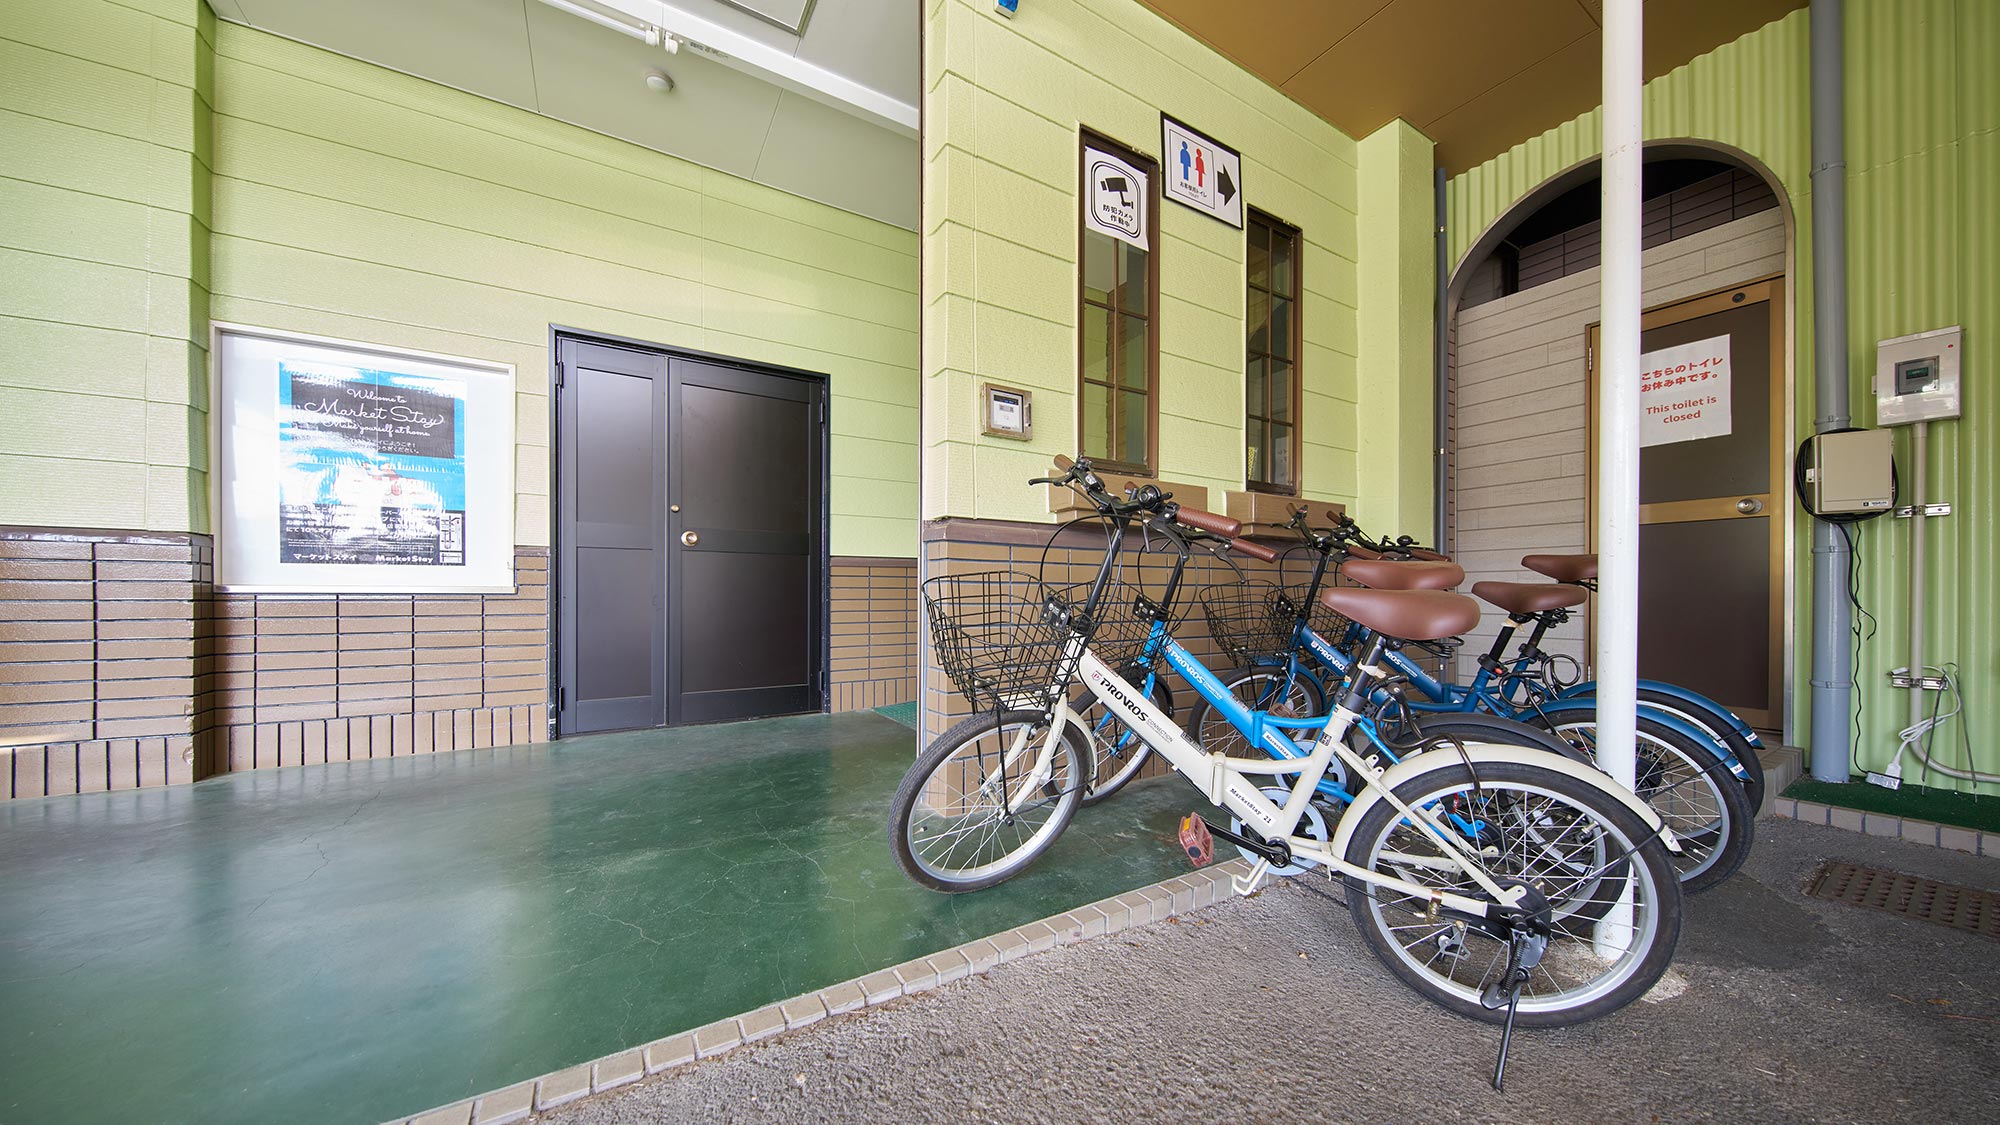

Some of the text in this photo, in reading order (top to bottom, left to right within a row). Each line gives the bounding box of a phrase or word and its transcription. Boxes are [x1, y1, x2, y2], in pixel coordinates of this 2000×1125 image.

[1180, 181, 1207, 198] お客様用トイレ
[1102, 204, 1134, 222] 防犯カメラ
[1110, 214, 1130, 227] 作動中
[1641, 357, 1723, 381] こちらのトイレ
[1641, 371, 1718, 392] お休み中です。
[346, 388, 407, 404] Welcome to
[1646, 395, 1717, 415] This toilet is
[304, 398, 444, 429] Market Stay
[1663, 410, 1701, 424] closed
[358, 424, 394, 438] yourself
[394, 426, 406, 435] at
[293, 553, 357, 561] マーケットステイ
[1171, 651, 1204, 684] PROVROS
[1316, 646, 1345, 672] PROVRO
[1100, 677, 1149, 722] PROVROS
[1148, 718, 1173, 742] CONNECTION
[1230, 788, 1272, 824] MarketStay 21
